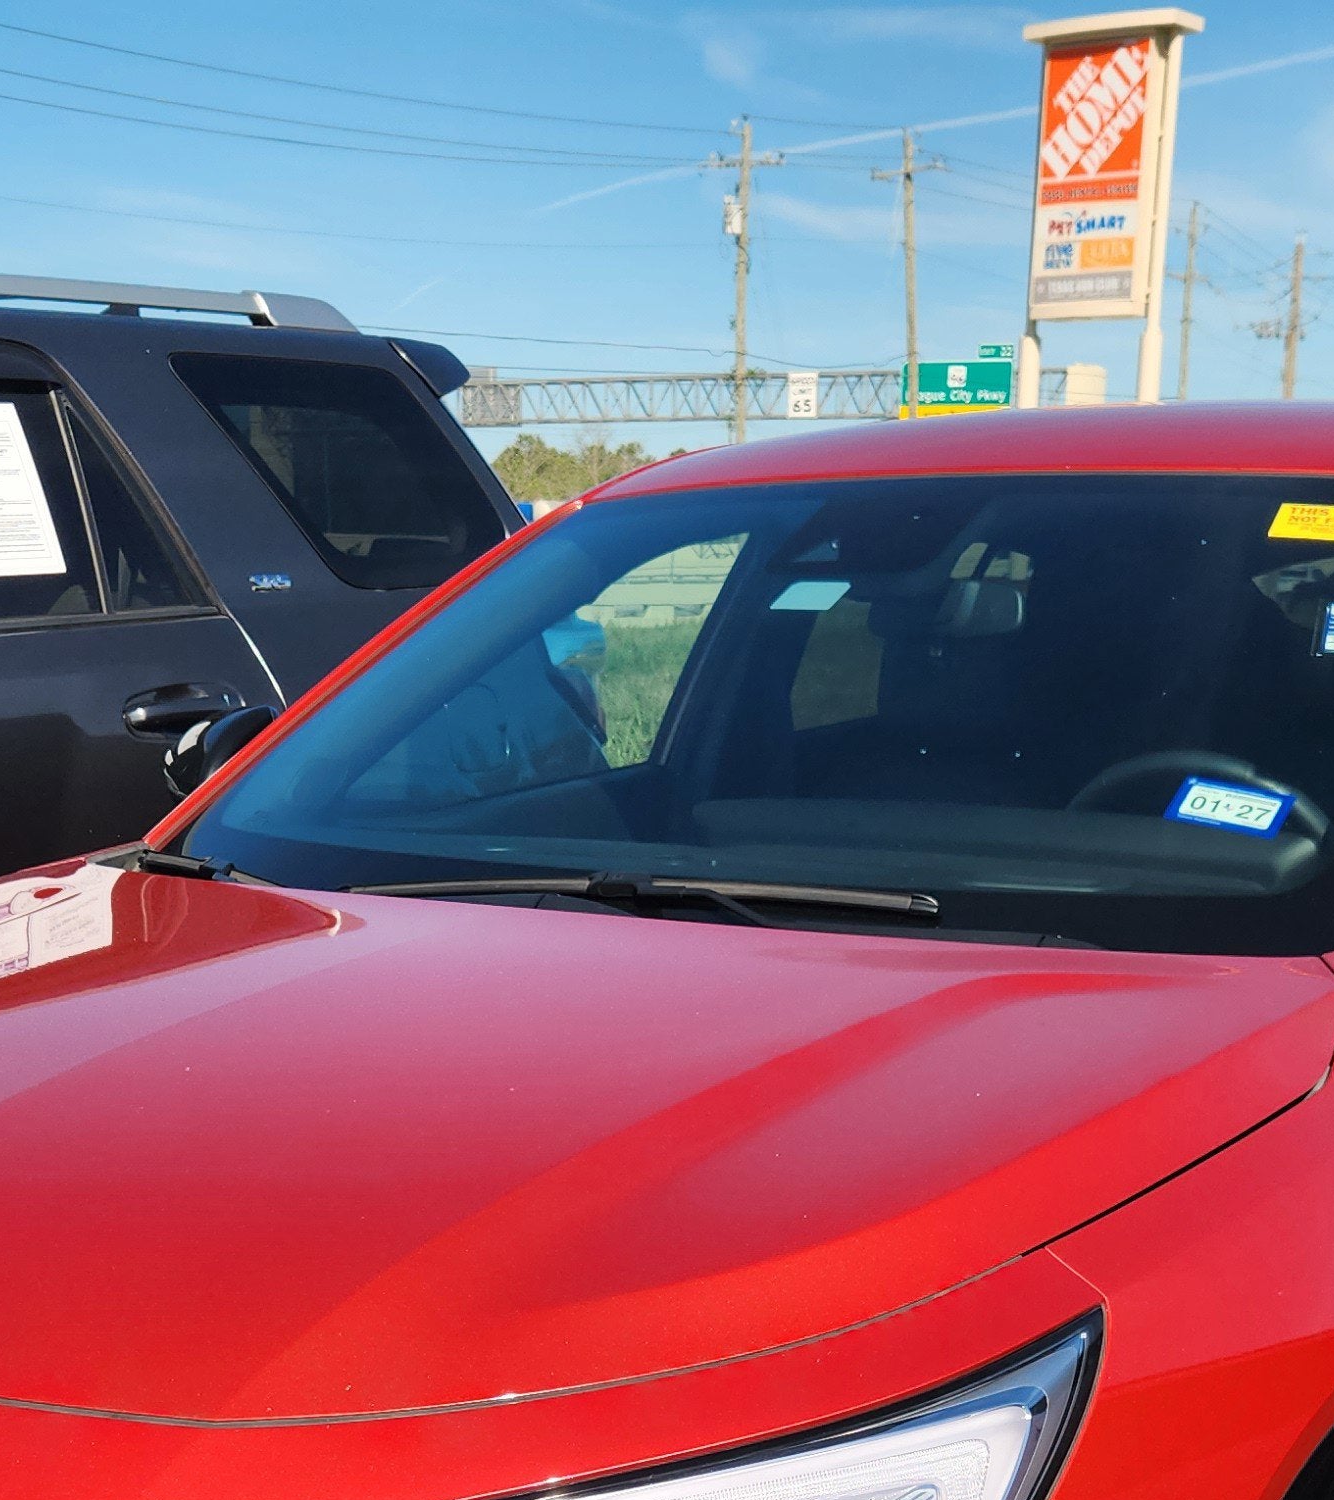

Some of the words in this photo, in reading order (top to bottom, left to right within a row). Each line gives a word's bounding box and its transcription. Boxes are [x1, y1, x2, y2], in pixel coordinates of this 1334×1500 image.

[1053, 56, 1100, 114] THE
[1041, 46, 1148, 181] HOME
[1079, 86, 1145, 177] DEPOT
[793, 398, 811, 412] 65
[949, 389, 974, 404] City
[1288, 515, 1318, 523] NOT
[1291, 506, 1330, 517] THIS
[1189, 796, 1222, 813] 01
[1234, 804, 1272, 822] 27
